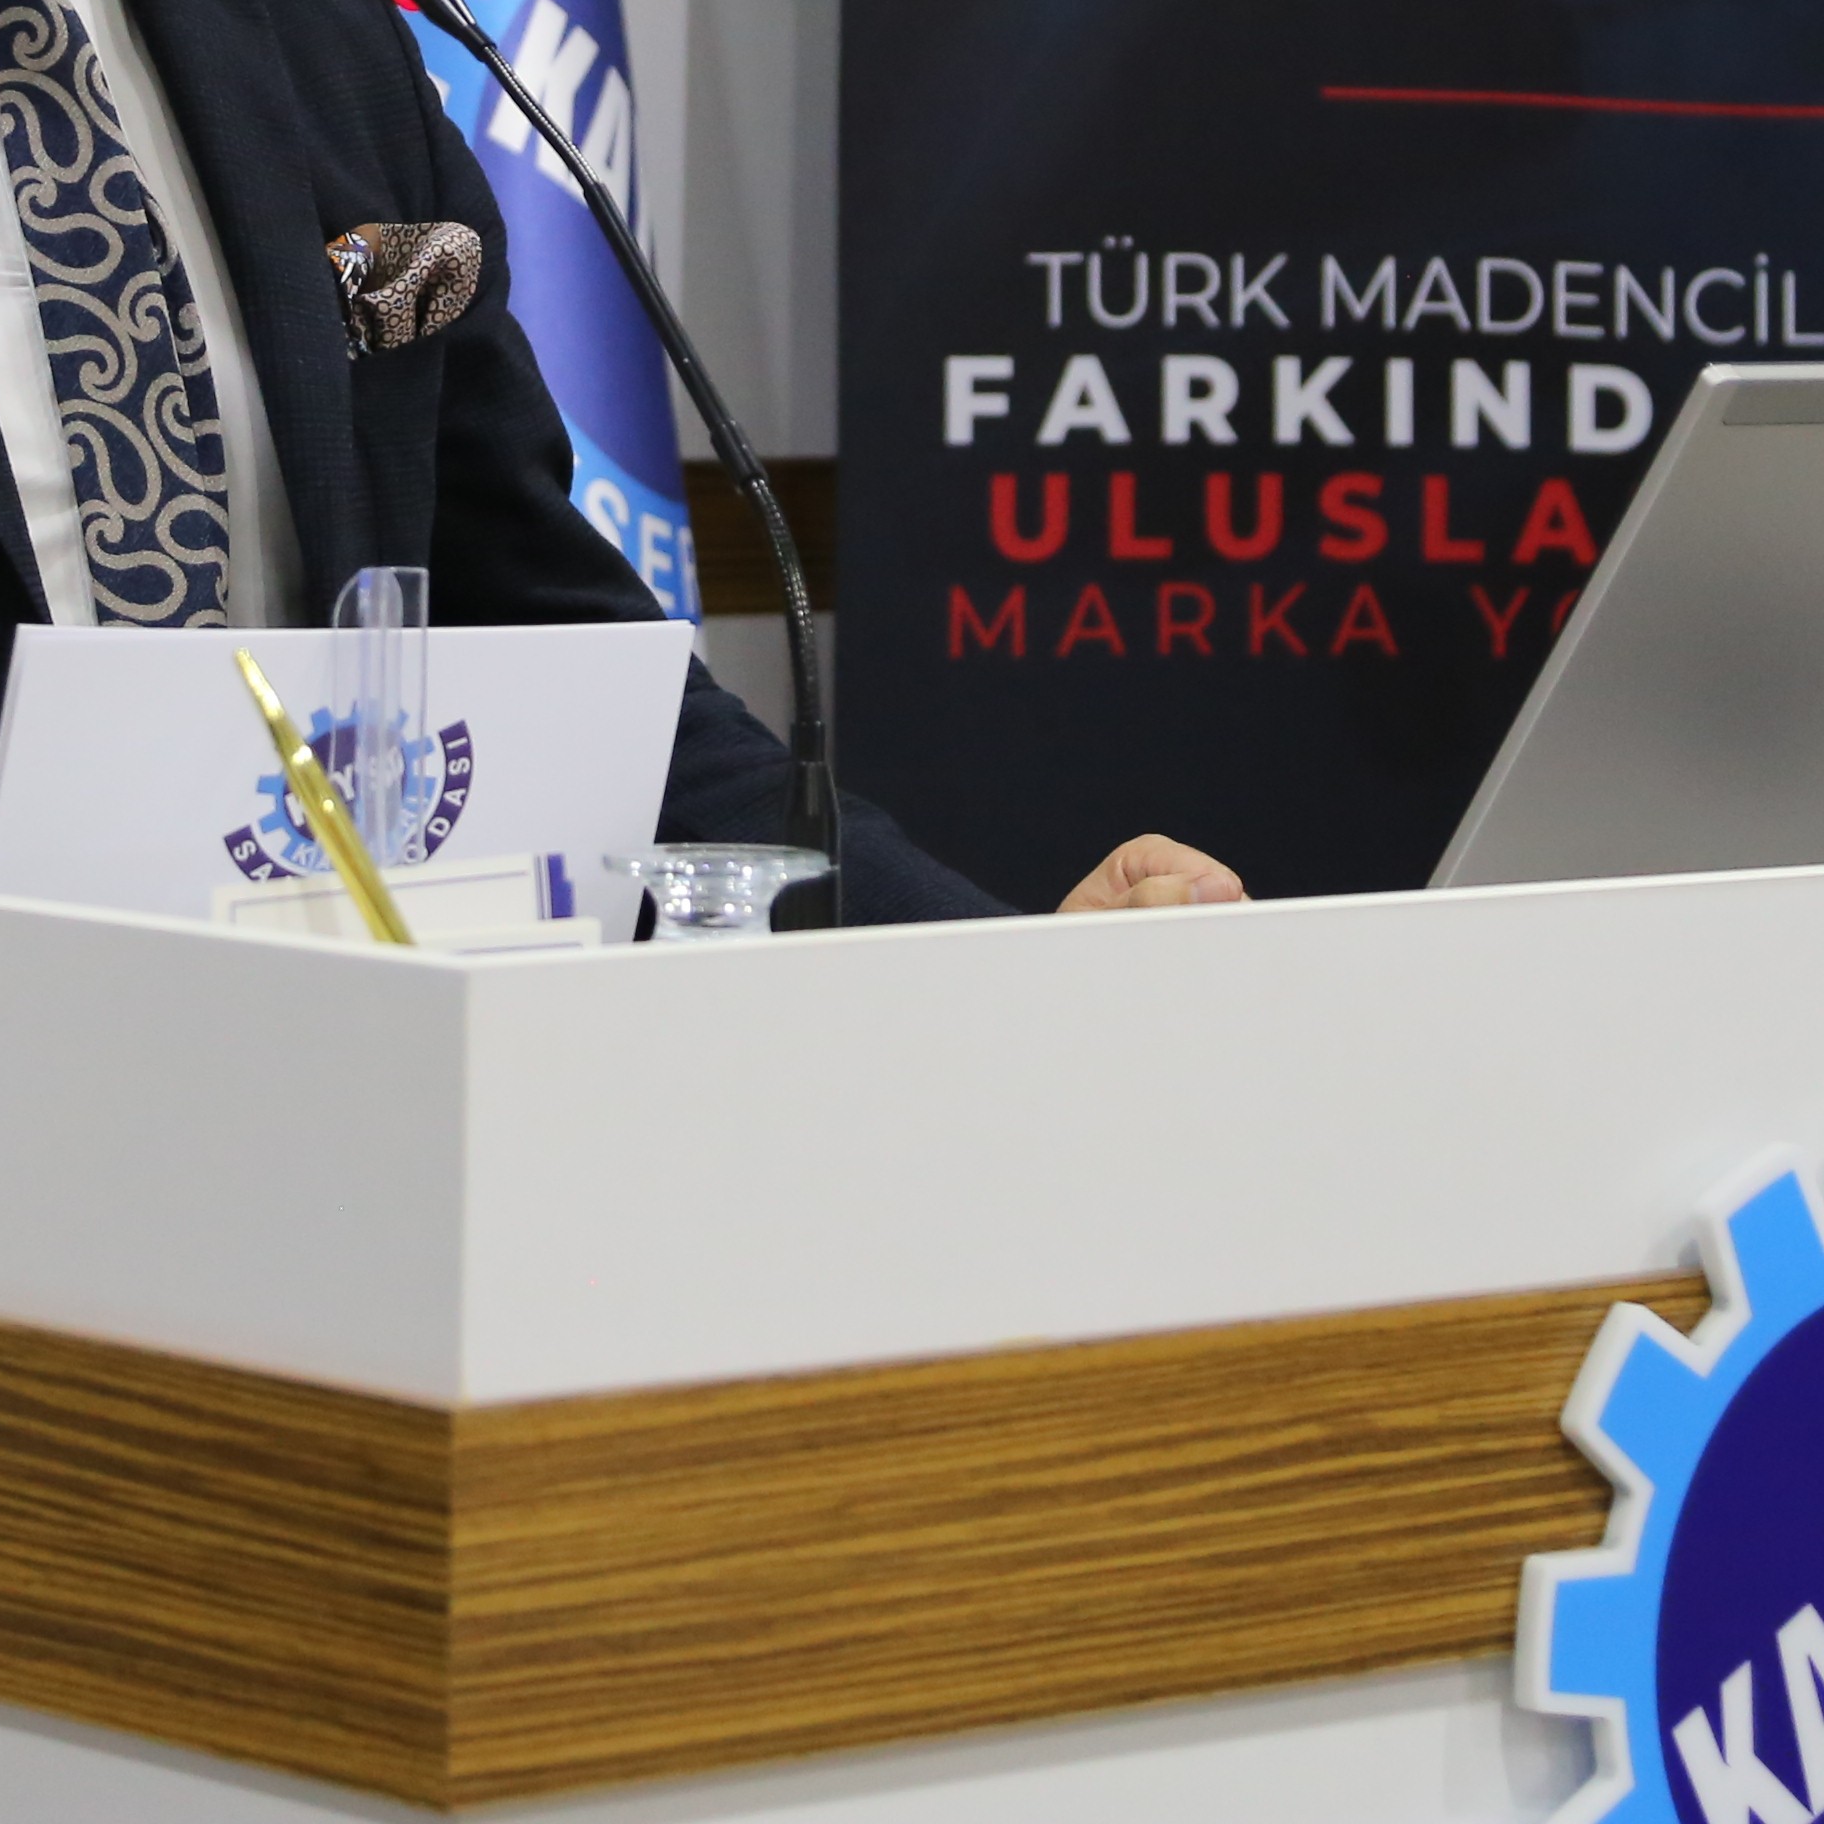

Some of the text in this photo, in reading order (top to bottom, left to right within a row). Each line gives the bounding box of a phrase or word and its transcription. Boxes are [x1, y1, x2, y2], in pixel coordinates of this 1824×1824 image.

[1026, 235, 1291, 330] TÜRK
[943, 354, 1654, 454] FARKIND
[987, 469, 1599, 567] ULUSLA
[947, 580, 1400, 659] MARKA
